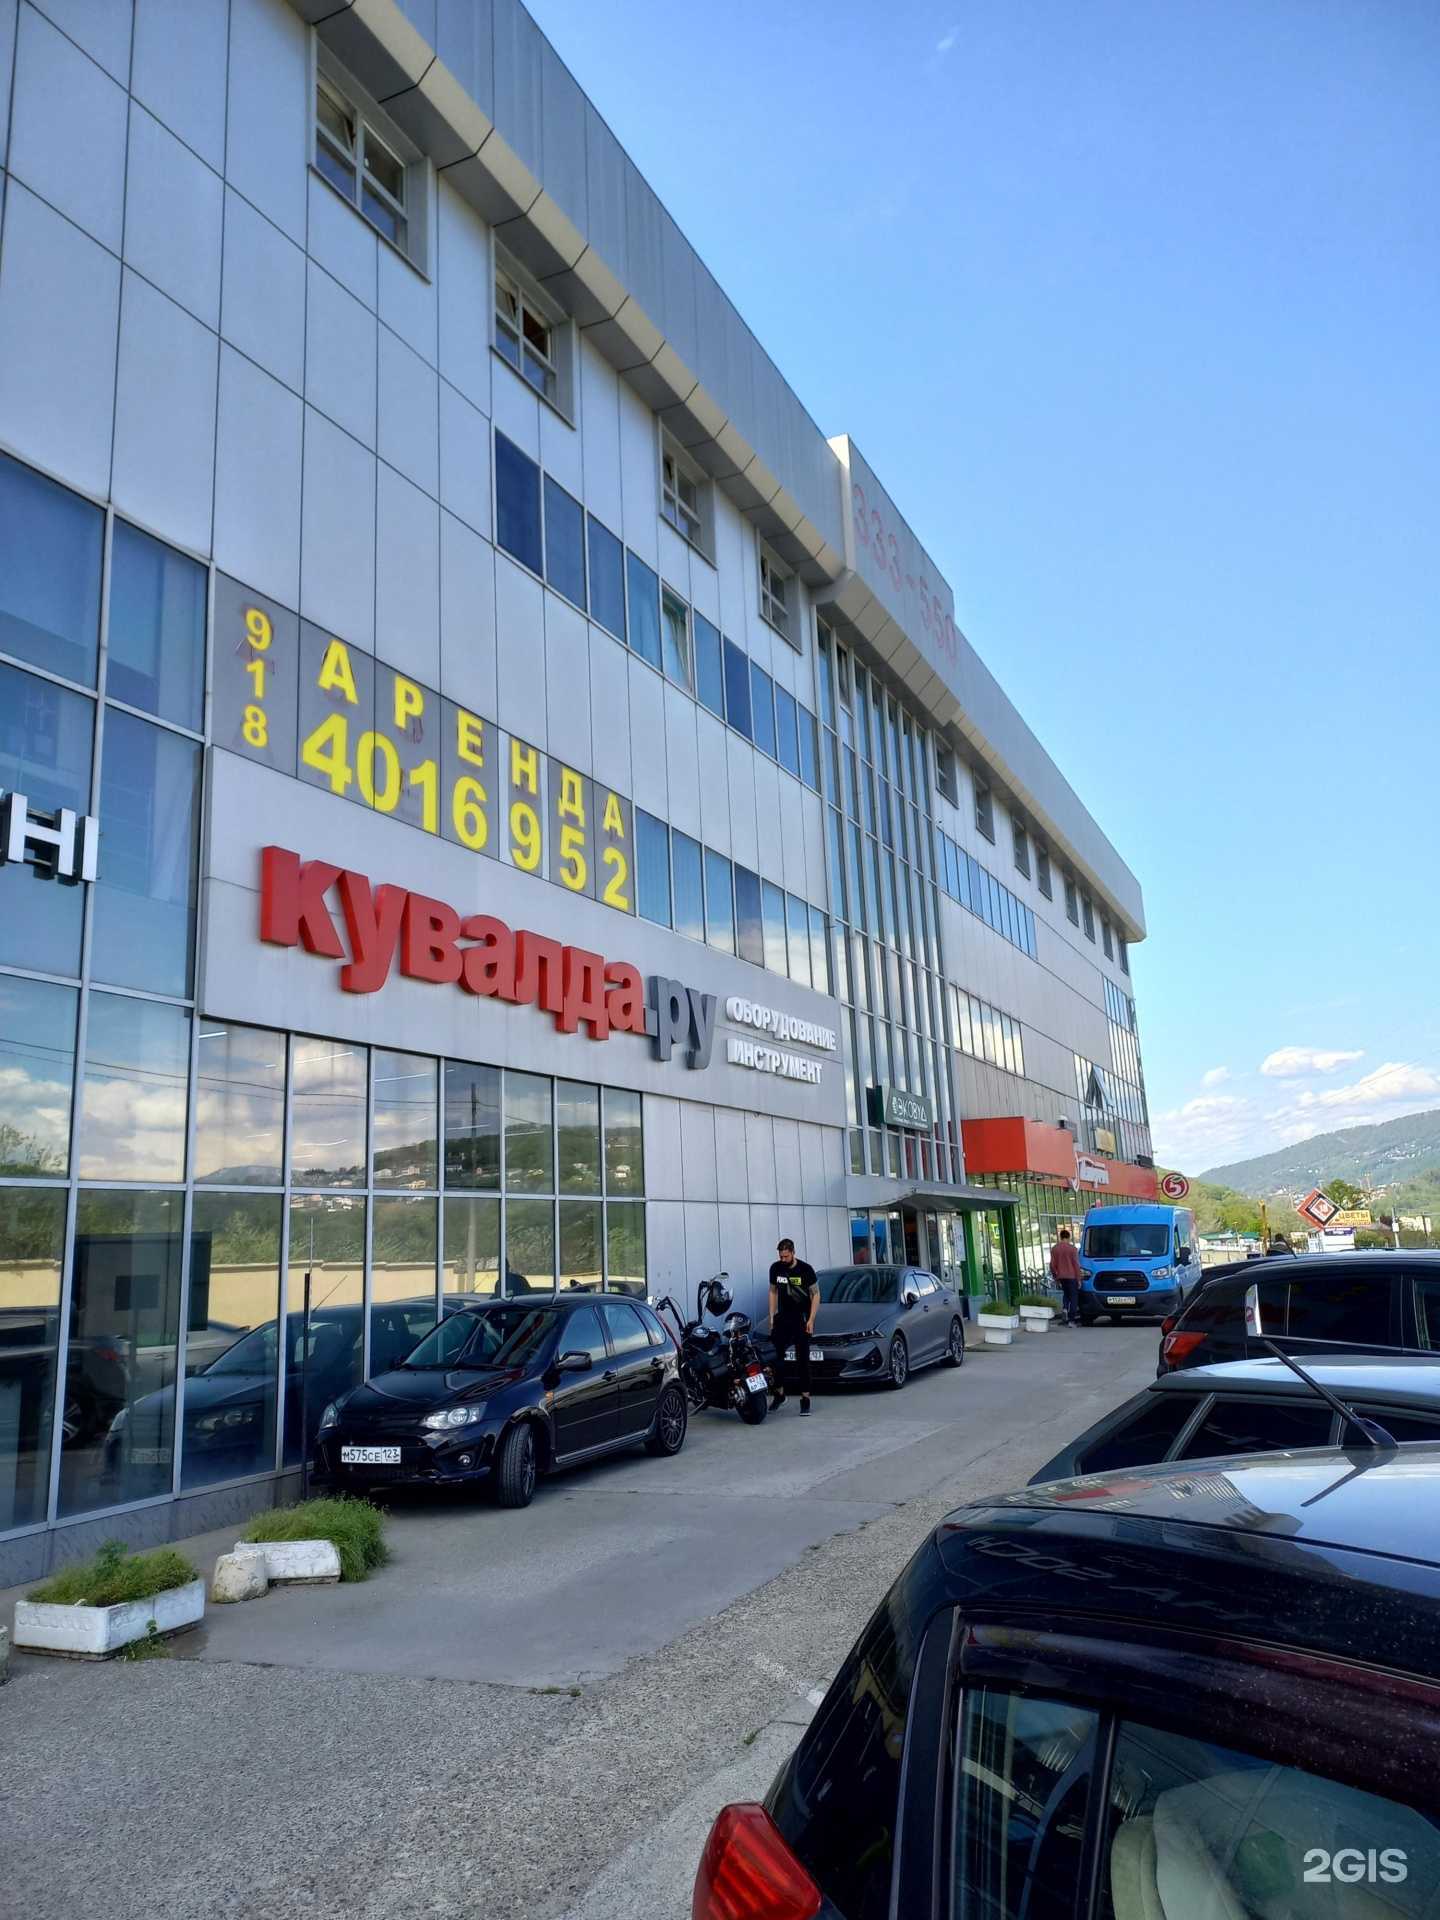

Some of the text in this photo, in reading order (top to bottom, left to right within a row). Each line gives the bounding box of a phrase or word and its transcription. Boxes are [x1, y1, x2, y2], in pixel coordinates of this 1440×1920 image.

[318, 639, 624, 838] АРЕНДА
[727, 996, 837, 1050] ОБОРУДОВАНИЕ
[727, 1038, 822, 1084] ИНСТРУМЕНТ
